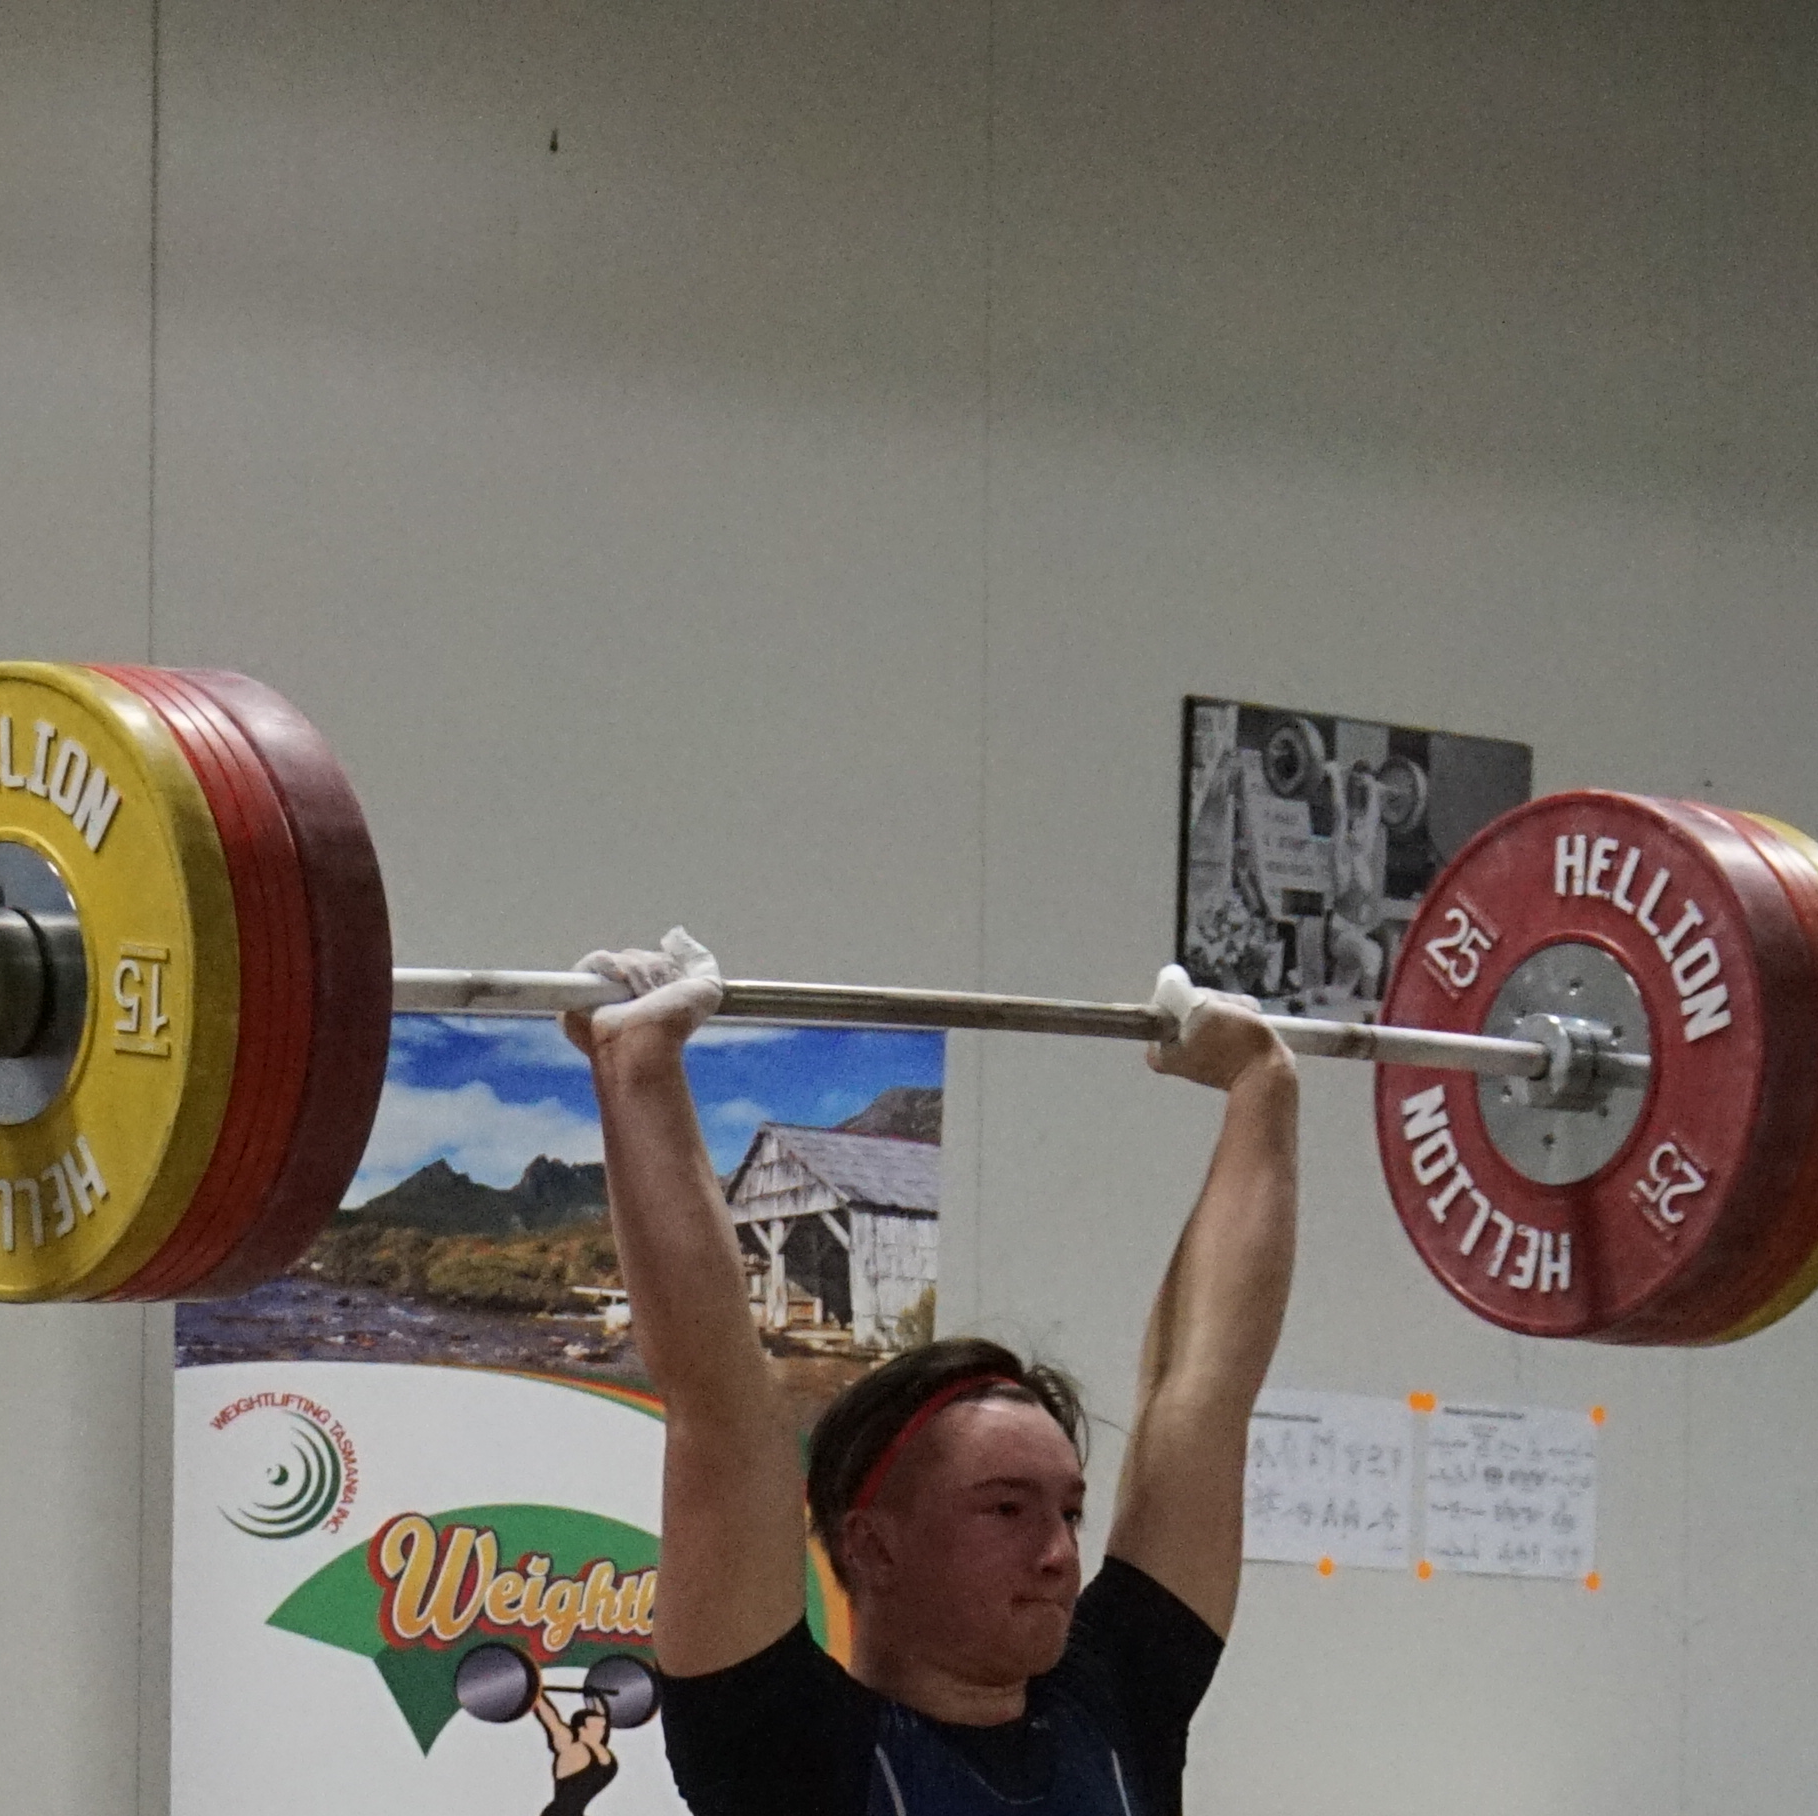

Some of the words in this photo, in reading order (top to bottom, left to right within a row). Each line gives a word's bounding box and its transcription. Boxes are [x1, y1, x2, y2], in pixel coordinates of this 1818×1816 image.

[1425, 908, 1492, 988] 25
[1554, 834, 1732, 1043] HELLION
[114, 958, 168, 1037] 15
[1400, 1083, 1572, 1294] HELLION
[1636, 1142, 1705, 1223] 25
[210, 1392, 331, 1430] WEIGHTLIFTING
[330, 1420, 359, 1504] TASMANIA
